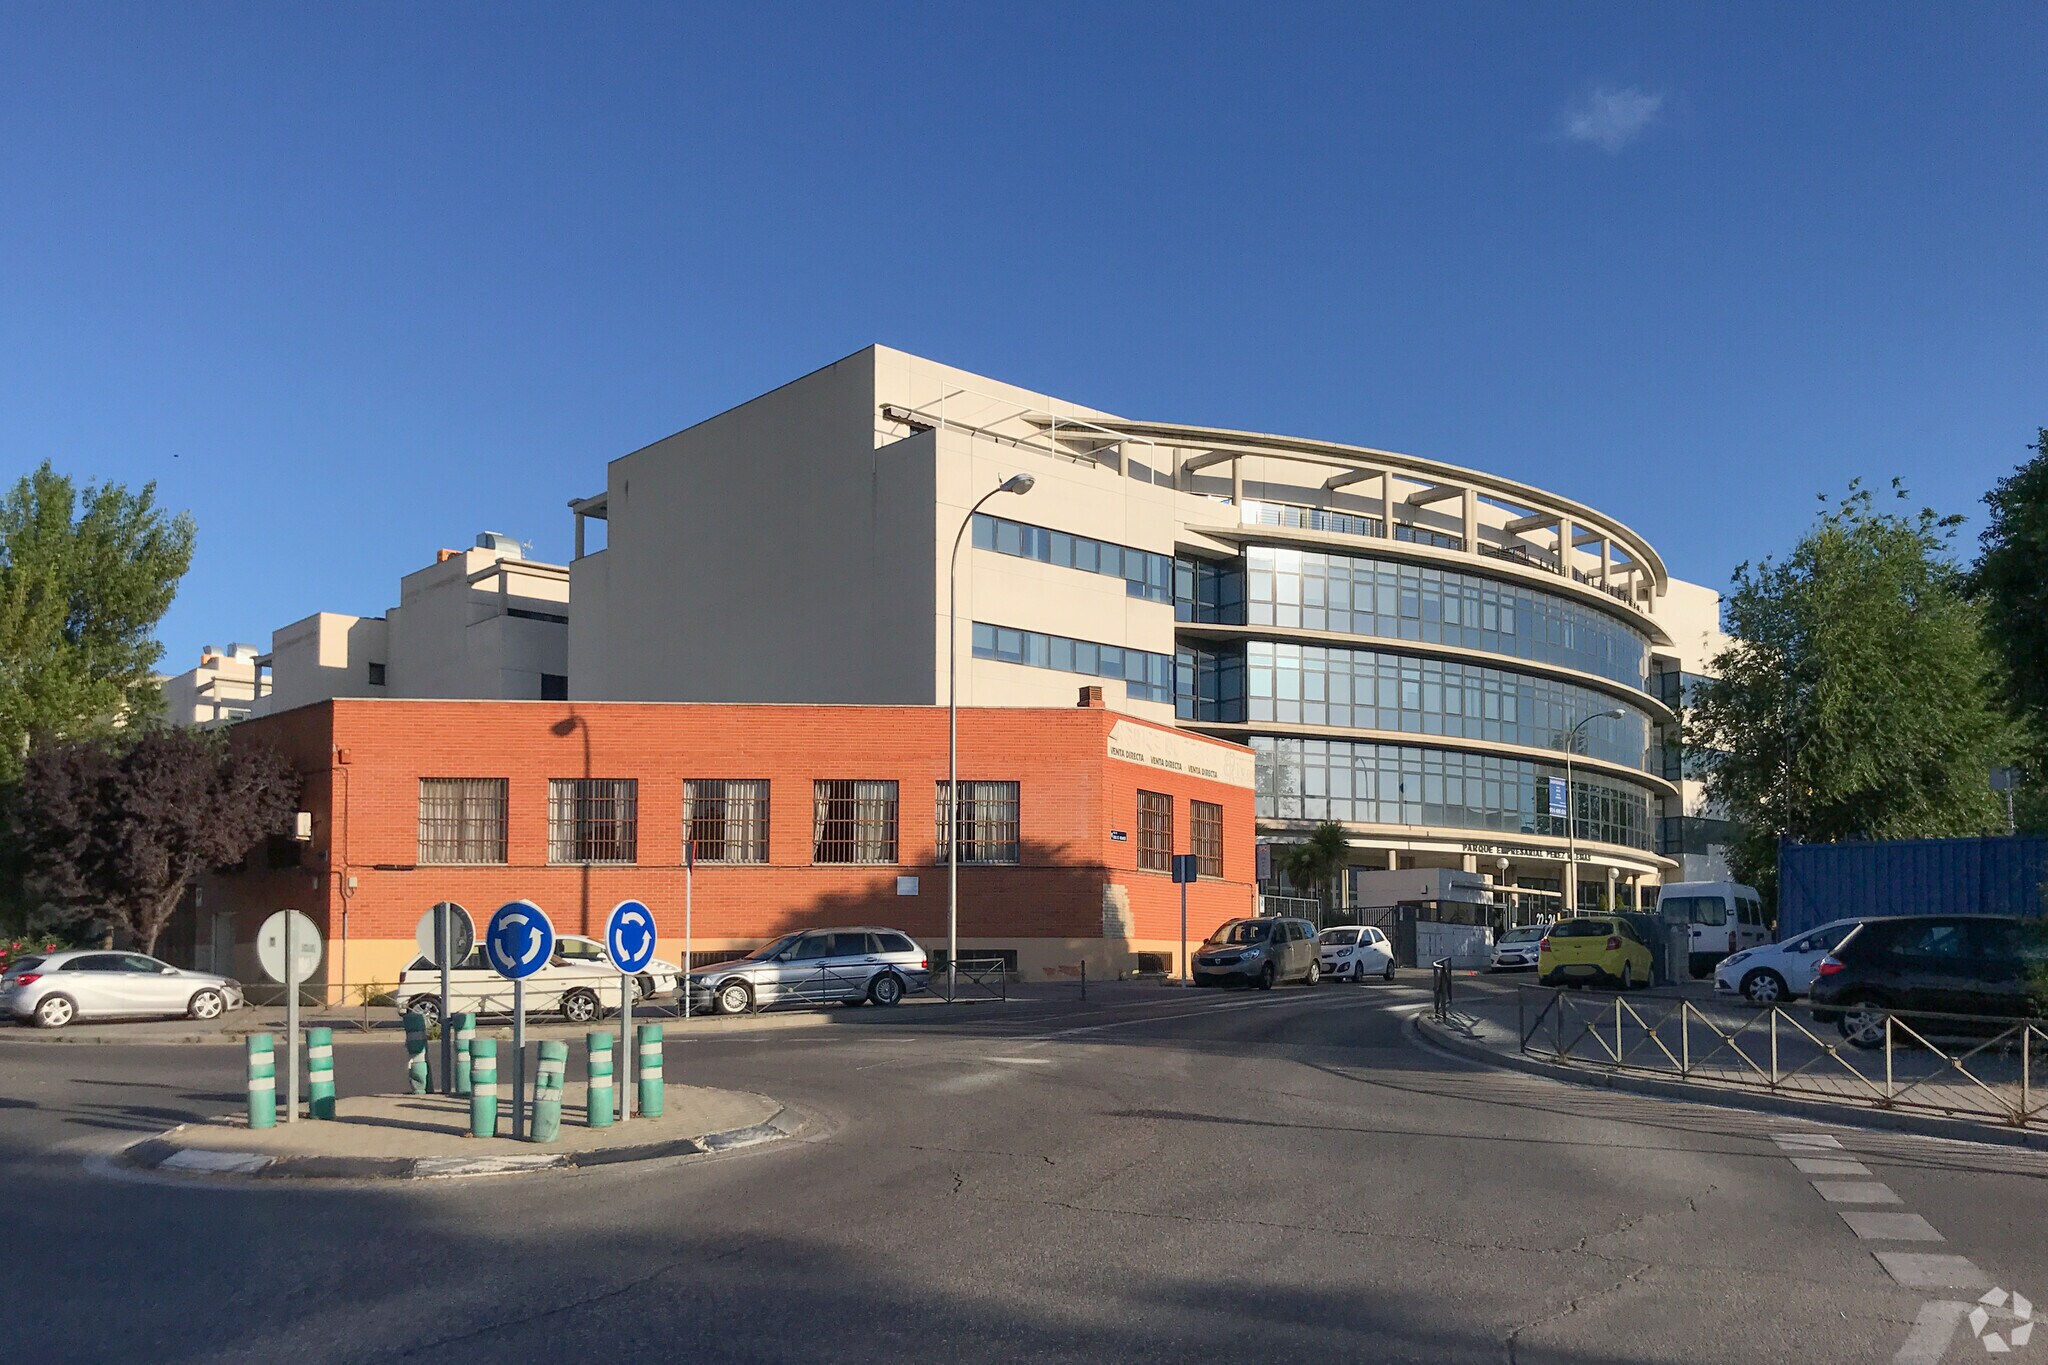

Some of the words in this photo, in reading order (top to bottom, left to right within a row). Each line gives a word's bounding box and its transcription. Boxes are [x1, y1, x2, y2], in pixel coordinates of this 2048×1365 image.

[1110, 747, 1125, 757] VENTA
[1126, 750, 1144, 762] DIRECTA
[1150, 757, 1164, 766] VENTA
[1165, 760, 1182, 771] DIRECTA
[1188, 765, 1201, 774] VENTA
[1202, 768, 1218, 778] DIRECTA
[1462, 844, 1494, 854] PARQUE
[1496, 846, 1544, 858] EMPRESARIAL
